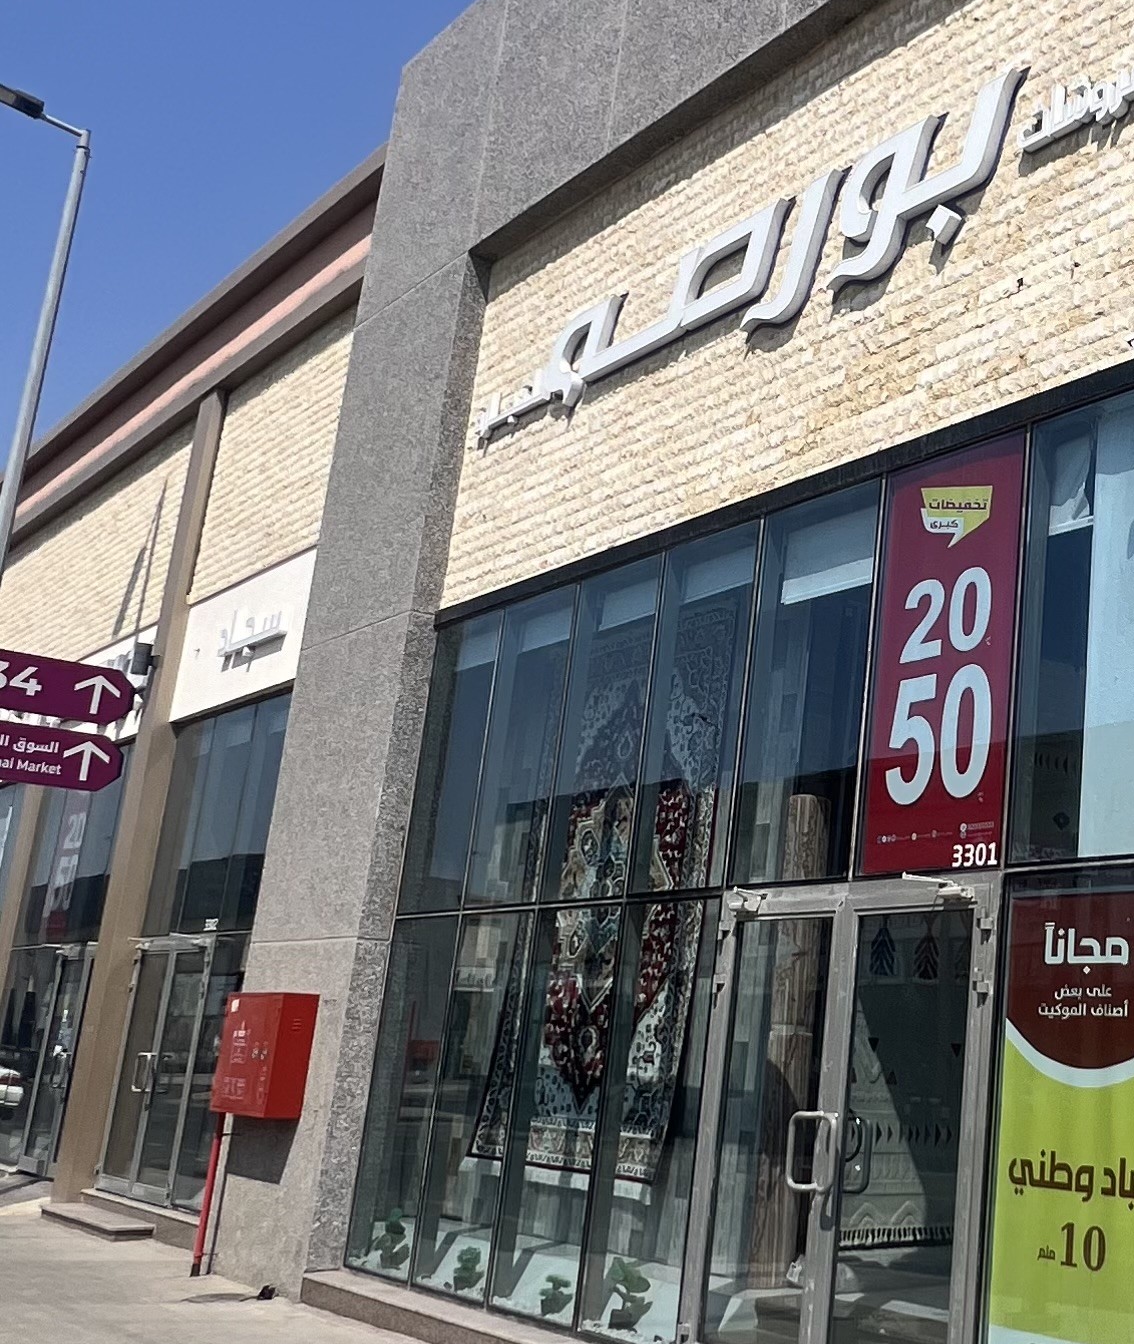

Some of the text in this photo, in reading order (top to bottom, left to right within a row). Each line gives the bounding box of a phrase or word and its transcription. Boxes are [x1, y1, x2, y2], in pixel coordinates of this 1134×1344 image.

[928, 498, 989, 514] تخفيضات
[899, 566, 992, 664] 20
[12, 737, 60, 755] السوق
[885, 663, 992, 806] 50
[16, 758, 62, 775] Market
[951, 841, 998, 868] 3301
[1054, 983, 1112, 1001] على بعض
[1037, 998, 1129, 1020] أصناف الموكيت
[1008, 1148, 1095, 1203] وطني
[1060, 1221, 1106, 1272] 10
